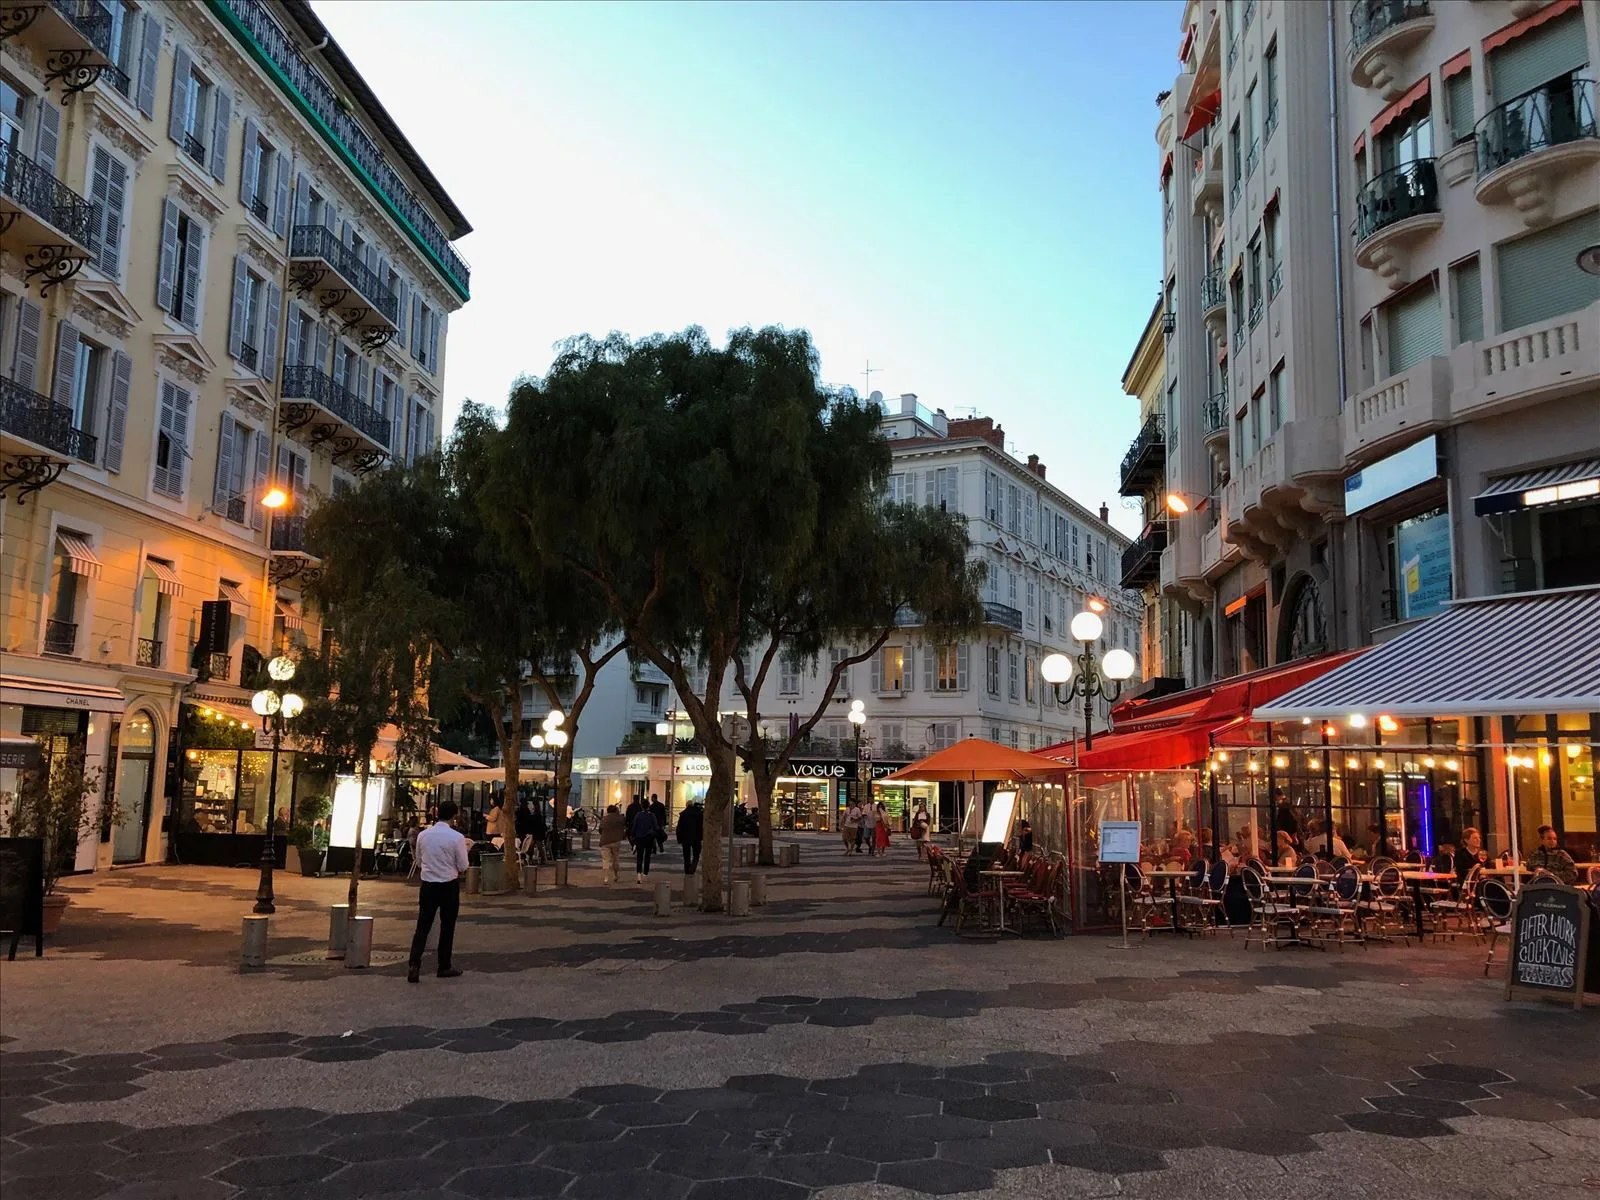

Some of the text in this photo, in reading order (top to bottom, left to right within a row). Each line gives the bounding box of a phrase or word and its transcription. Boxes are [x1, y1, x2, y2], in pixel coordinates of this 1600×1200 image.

[66, 698, 90, 707] CHANEL
[1, 753, 26, 765] SERIE
[1520, 914, 1576, 948] AFTER WORK
[1518, 962, 1575, 988] TAPAS
